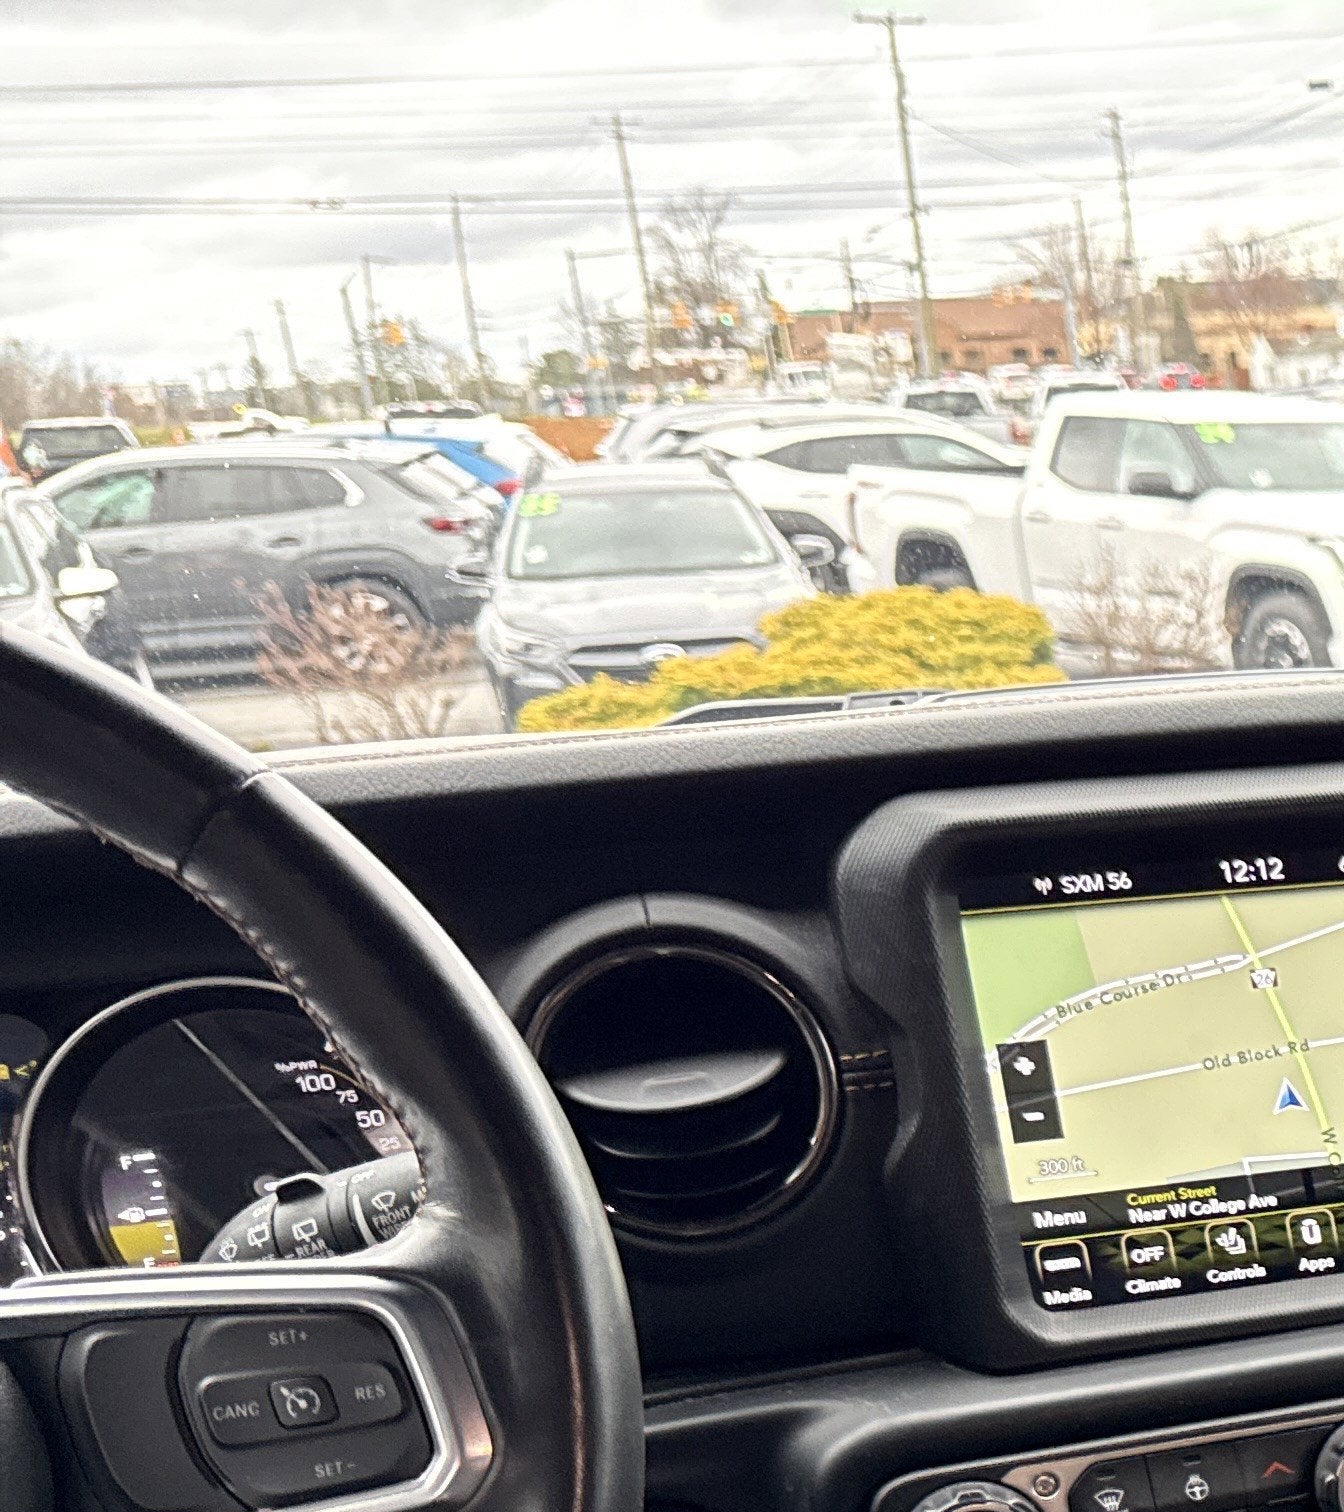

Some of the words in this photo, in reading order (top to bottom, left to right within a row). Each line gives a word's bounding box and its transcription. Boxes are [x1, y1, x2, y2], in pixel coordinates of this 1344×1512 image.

[1219, 857, 1285, 883] 12:12
[1059, 874, 1104, 894] SXM
[1105, 871, 1133, 891] 56
[1256, 973, 1273, 986] 26
[1056, 1001, 1094, 1019] Blue
[1099, 981, 1158, 1005] Course
[1161, 973, 1183, 988] Dr
[1202, 1051, 1231, 1071] Old
[1237, 1043, 1283, 1065] Block
[1287, 1038, 1310, 1054] Rd
[295, 1074, 336, 1093] 100
[335, 1089, 359, 1104] 75
[355, 1109, 386, 1128] 50
[379, 1136, 401, 1151] 25
[1321, 1127, 1338, 1144] W
[119, 1156, 131, 1170] F
[1039, 1159, 1069, 1175] 300
[1070, 1156, 1085, 1172] ft
[1126, 1190, 1178, 1207] Current
[1179, 1185, 1217, 1201] Street
[372, 1205, 411, 1229] FRONT
[1127, 1206, 1168, 1224] Near
[1167, 1203, 1187, 1219] W
[1189, 1199, 1246, 1218] College
[1248, 1193, 1278, 1210] Ave
[1032, 1209, 1087, 1228] Menu
[295, 1238, 327, 1258] REAR
[1130, 1246, 1165, 1264] OFF
[1206, 1263, 1267, 1284] Controls
[1298, 1256, 1335, 1273] Apps
[1125, 1275, 1182, 1295] Climate
[1042, 1287, 1092, 1306] Media
[354, 1383, 387, 1401] RES
